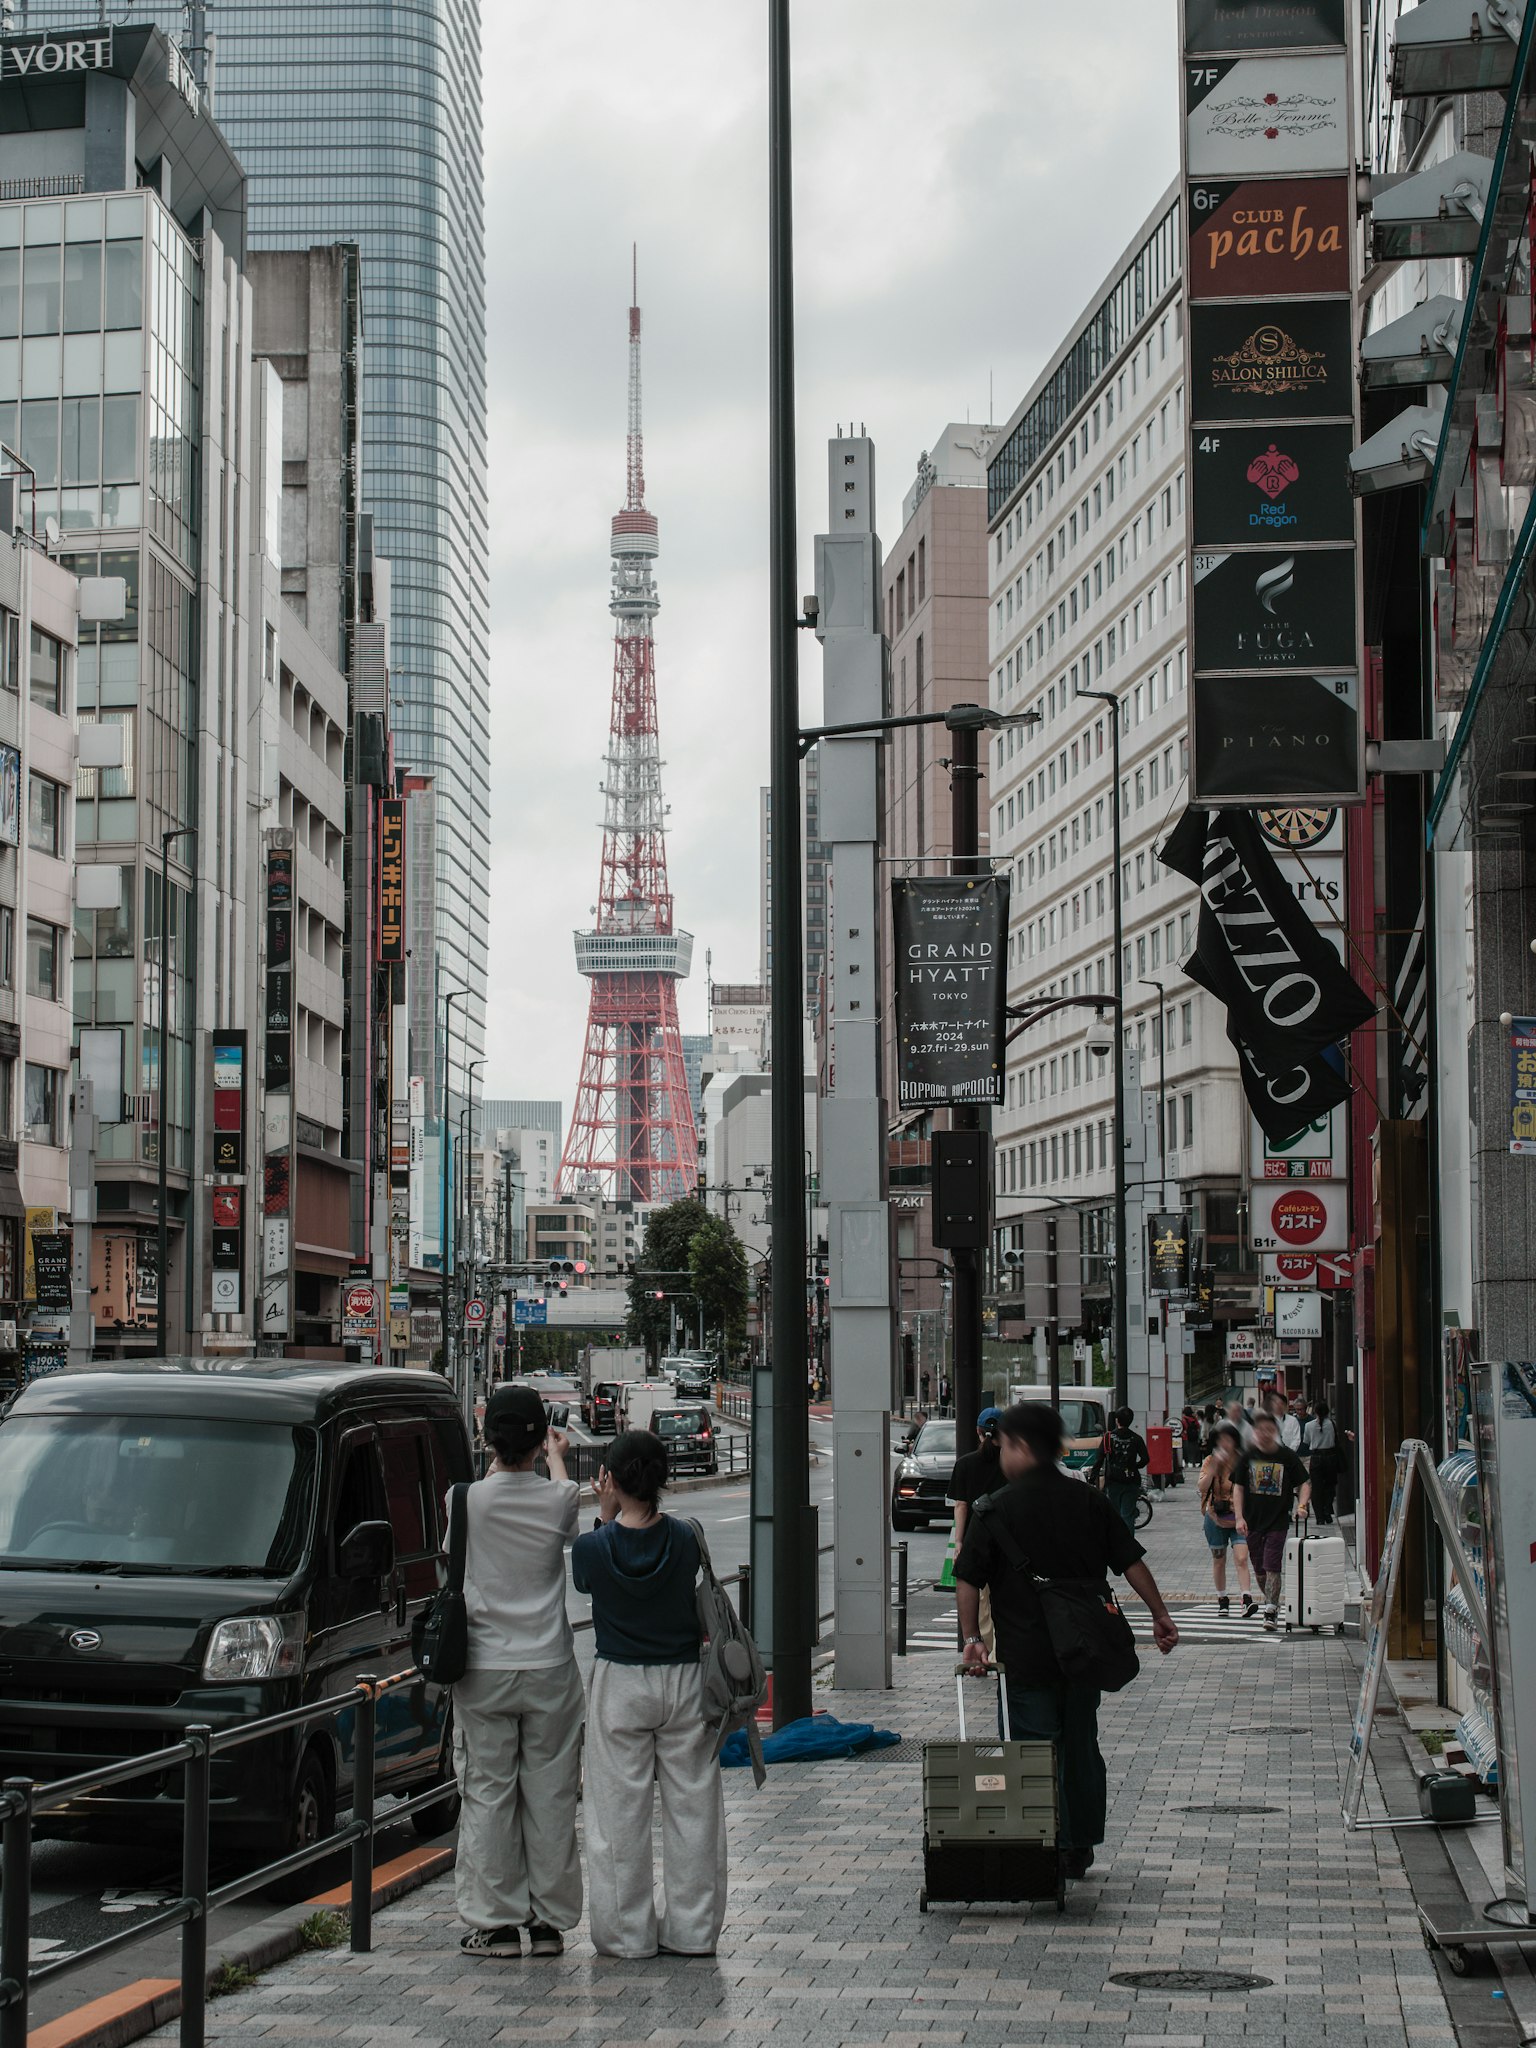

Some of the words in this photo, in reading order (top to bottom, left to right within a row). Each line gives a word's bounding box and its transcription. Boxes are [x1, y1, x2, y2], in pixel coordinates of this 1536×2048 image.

[11, 38, 110, 75] VORT
[1190, 68, 1218, 86] 7F
[1212, 110, 1260, 125] Belle
[1265, 109, 1332, 123] Femme
[1193, 188, 1220, 210] 6F
[1232, 209, 1284, 225] CLUB
[1207, 206, 1342, 269] pacha
[1211, 367, 1264, 382] SALON
[1266, 365, 1328, 380] SHILICA
[1199, 437, 1221, 453] 4F
[1260, 503, 1286, 515] Red
[1249, 513, 1297, 528] Dragon
[1196, 556, 1216, 570] 3F
[1238, 632, 1314, 650] FUGA
[1257, 653, 1296, 661] TOKYO
[1335, 682, 1349, 694] B1
[1223, 735, 1330, 748] PIANO
[908, 943, 992, 958] GRAND
[910, 967, 990, 983] HYATT
[910, 1020, 990, 1031] 六本木アートナイト
[936, 1032, 963, 1041] 2024
[1264, 1161, 1286, 1176] たばこ
[1291, 1161, 1305, 1176] 酒
[1310, 1161, 1331, 1176] ATM
[1280, 1213, 1321, 1229] ガスト
[1254, 1238, 1277, 1248] B1F
[1282, 1258, 1312, 1269] ガスト
[351, 1296, 372, 1306] 消火栓
[1282, 1297, 1305, 1321] MUSIUM
